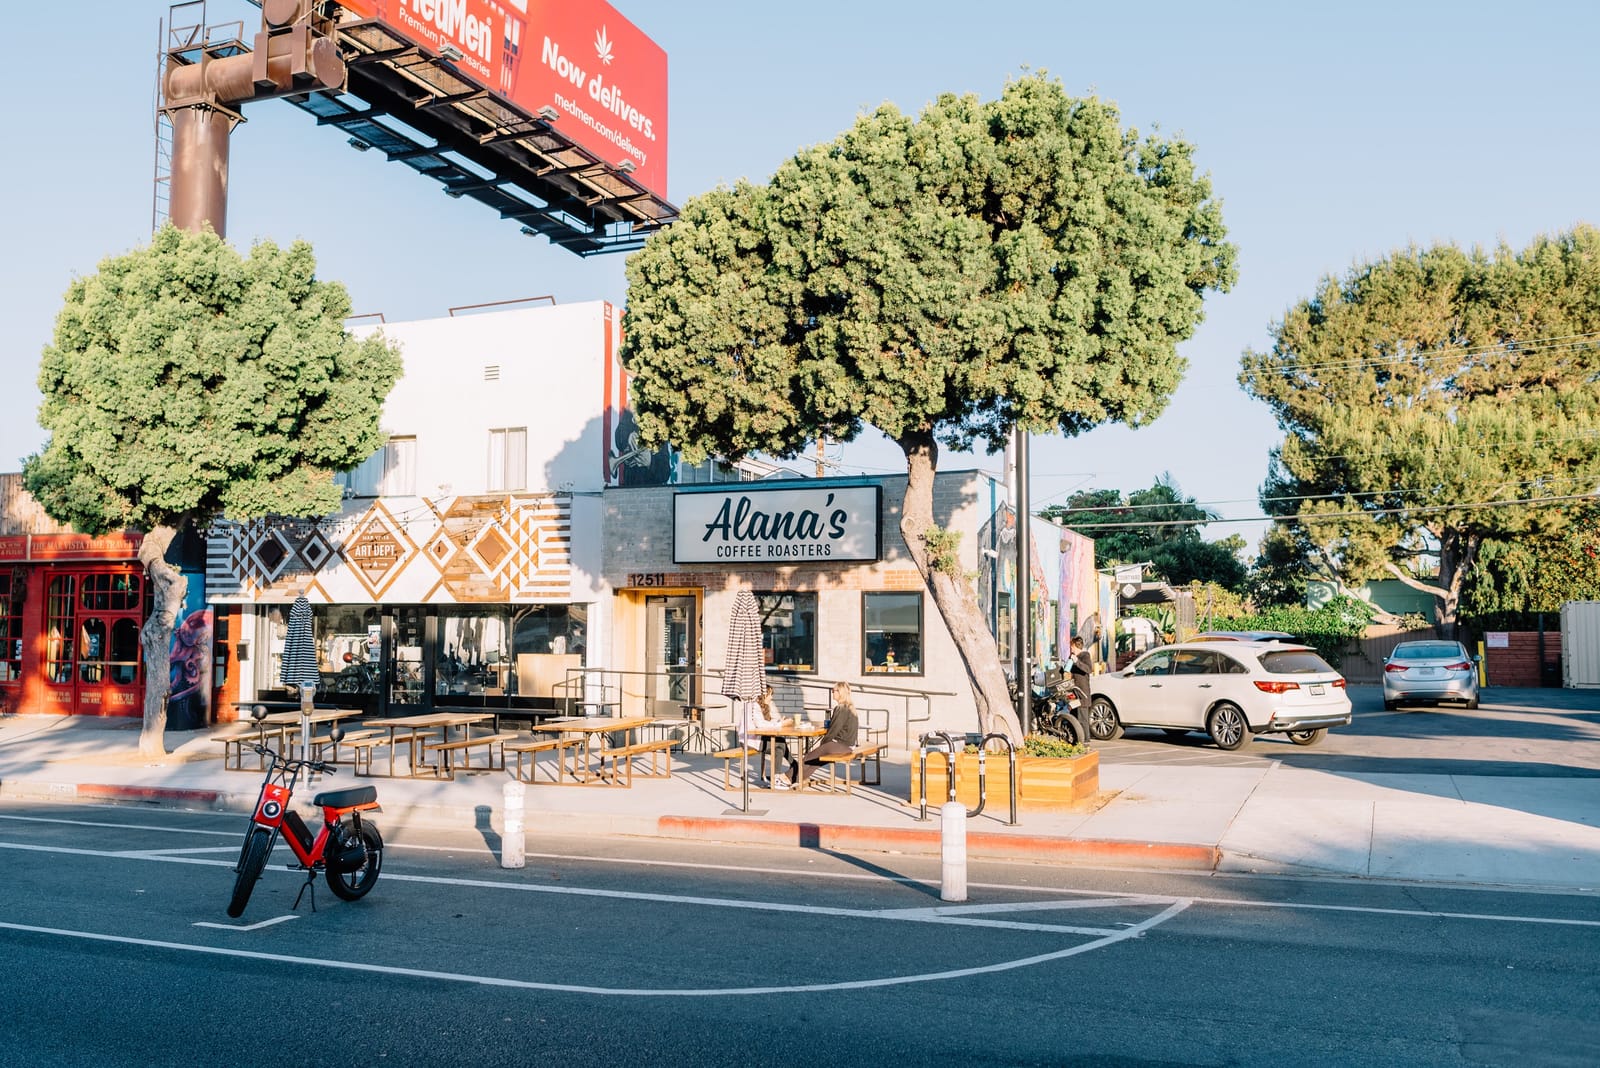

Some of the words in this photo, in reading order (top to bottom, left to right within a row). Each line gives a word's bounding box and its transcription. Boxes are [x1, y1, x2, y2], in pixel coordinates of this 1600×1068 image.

[390, 0, 492, 63] edMen
[399, 6, 438, 43] Premium
[440, 35, 491, 78] Dnsaries
[541, 35, 586, 88] Now
[588, 73, 656, 141] delivers.
[554, 92, 647, 167] medmen.com/delivery
[702, 493, 848, 542] Alana's
[64, 540, 85, 550] VISTA
[355, 544, 371, 557] ART
[716, 545, 761, 558] COFFEE
[767, 543, 831, 557] ROASTERS
[630, 572, 665, 586] 12511
